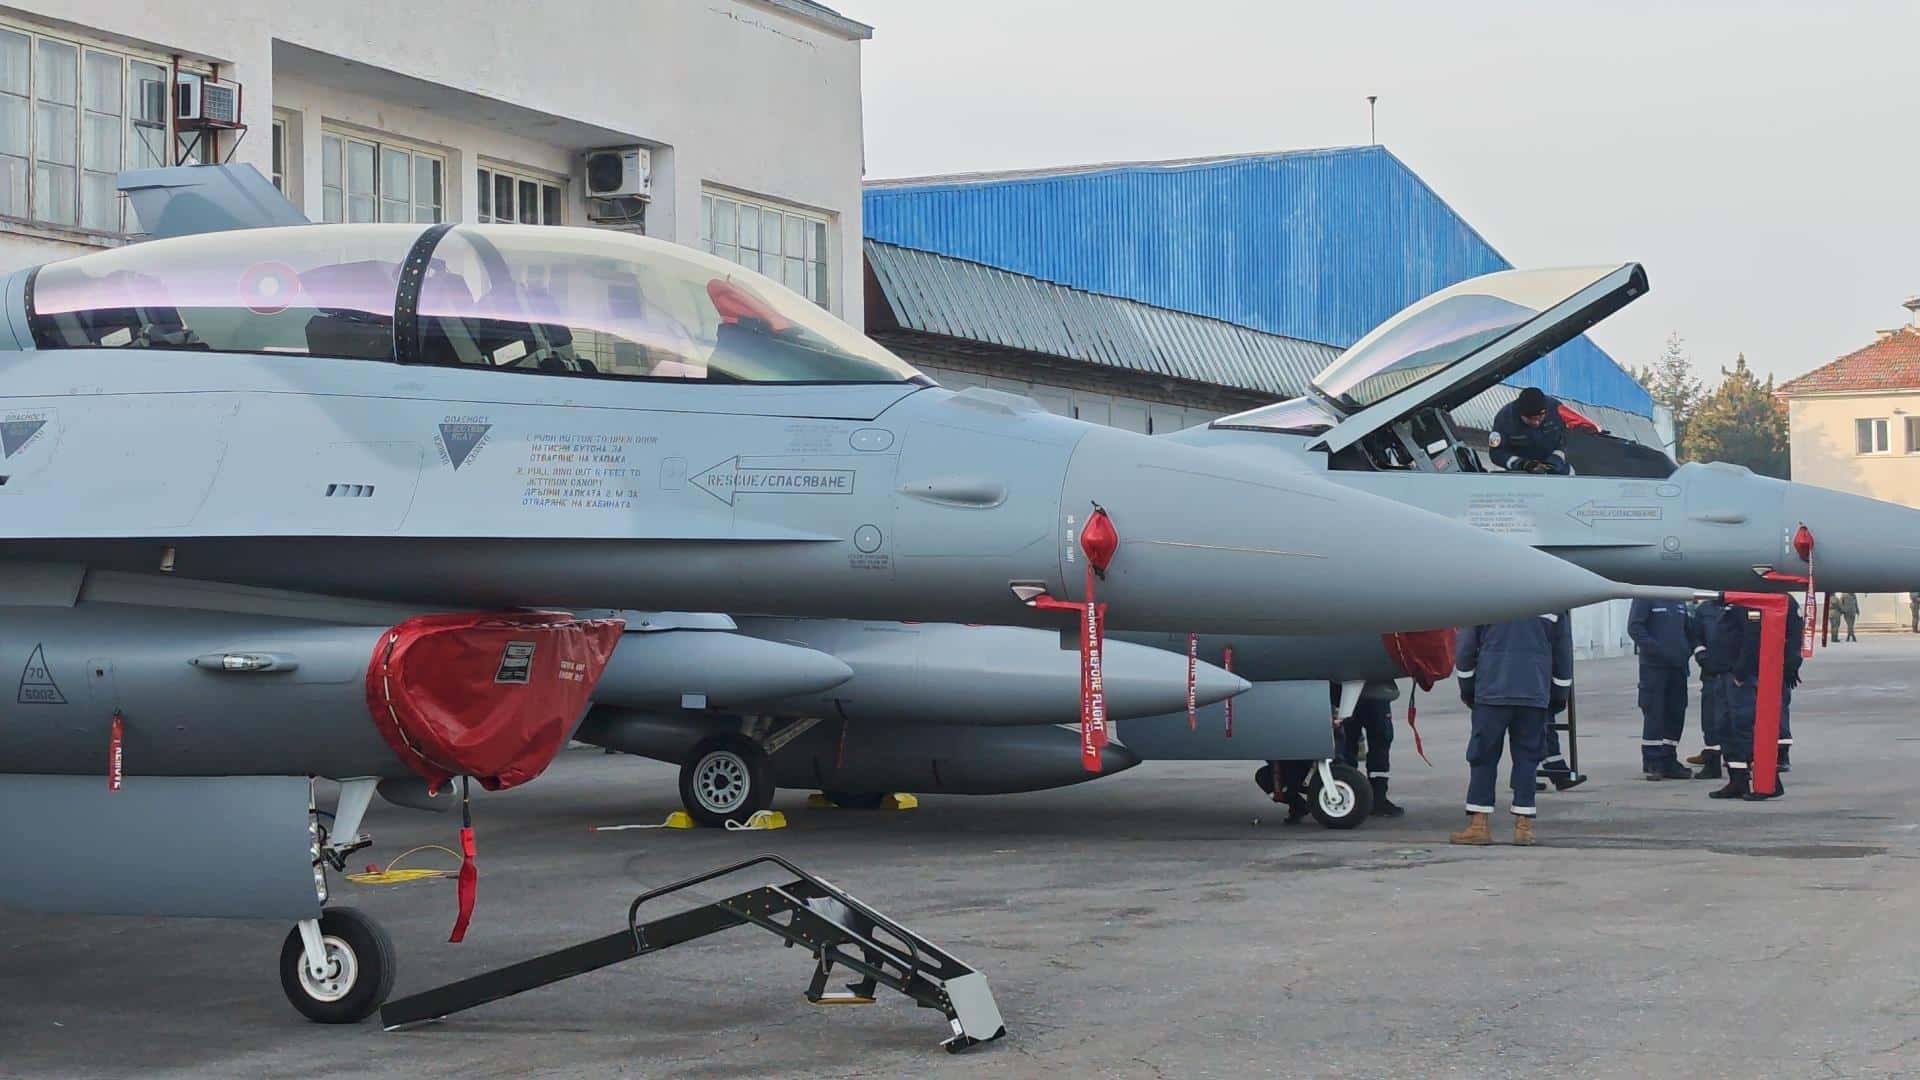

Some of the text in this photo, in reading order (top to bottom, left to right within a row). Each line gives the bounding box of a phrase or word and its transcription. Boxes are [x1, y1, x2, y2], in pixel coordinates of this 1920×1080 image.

[707, 475, 847, 488] RESCUE/СПАСЯВАНЕ
[29, 667, 44, 680] 70
[1089, 648, 1102, 692] BEFORE
[1091, 693, 1104, 732] FLIGHT
